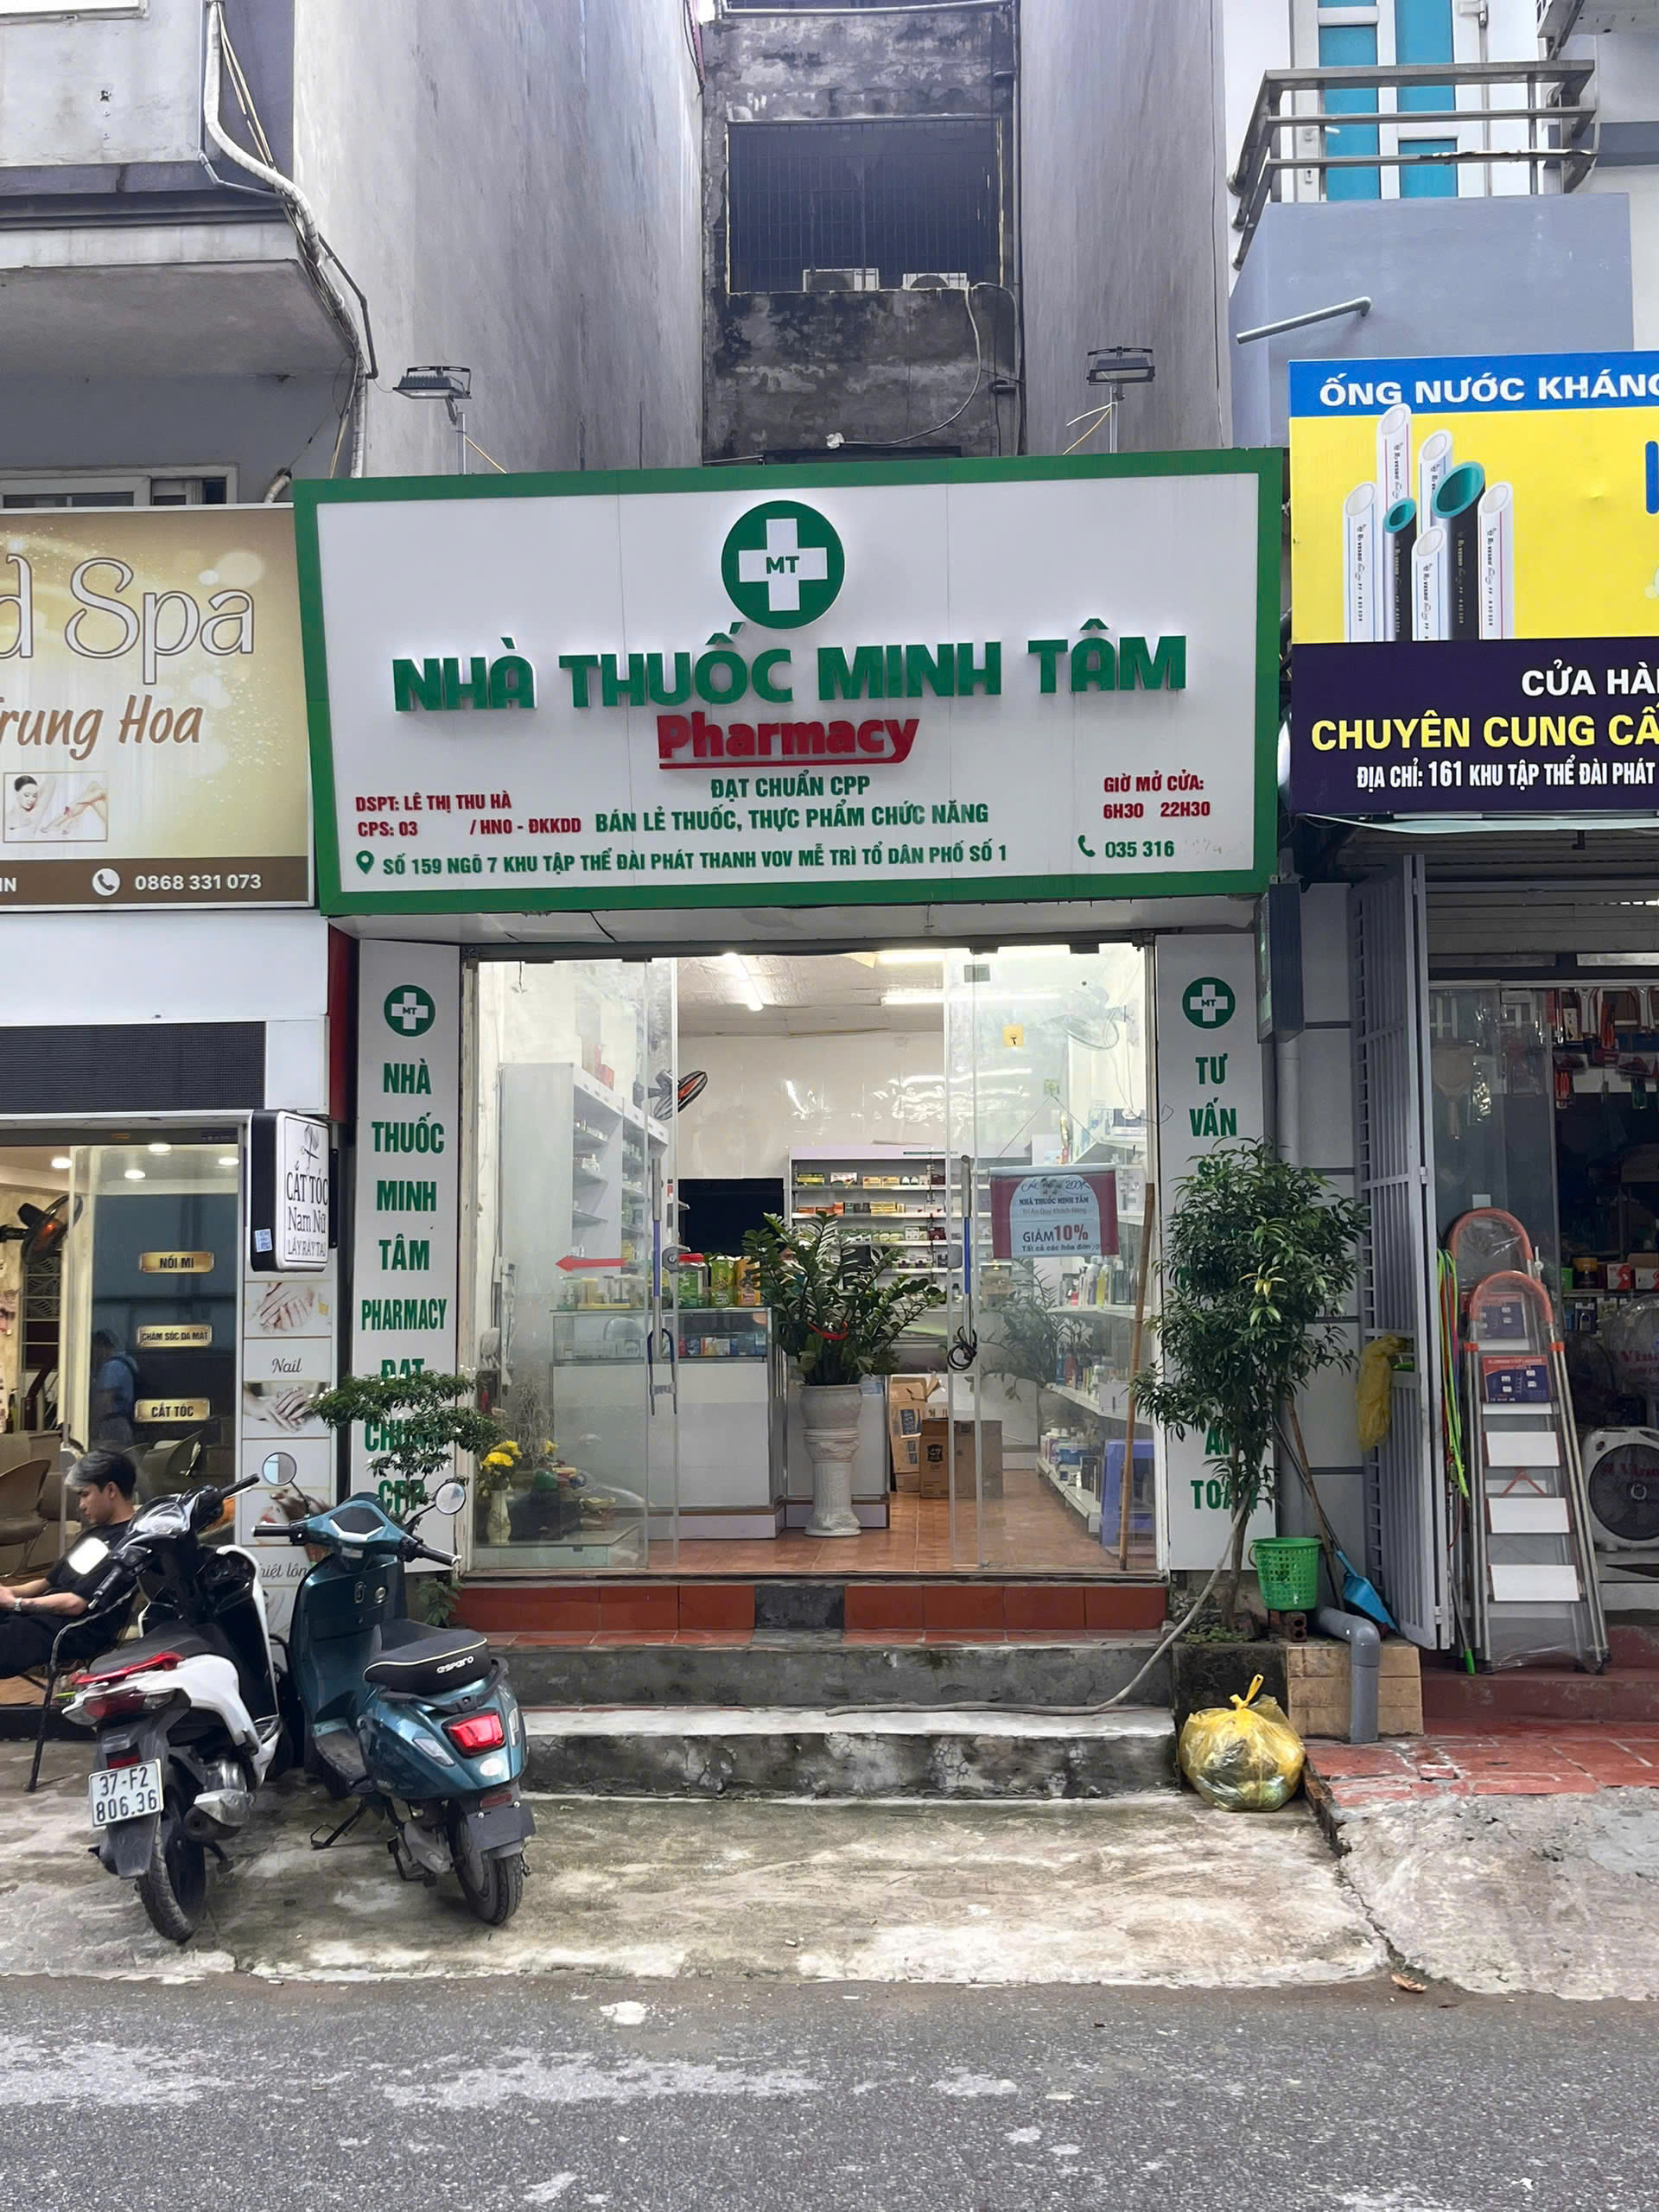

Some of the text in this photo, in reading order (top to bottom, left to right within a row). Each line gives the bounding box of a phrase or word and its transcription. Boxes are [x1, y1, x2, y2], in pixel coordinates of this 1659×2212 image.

[1319, 373, 1402, 406] ỐNG
[1415, 372, 1525, 404] NƯỚC
[766, 556, 800, 574] MT
[64, 556, 254, 685] Spa
[392, 618, 1187, 711] NHÀ THUỐC MINH TÂM
[1522, 658, 1659, 696] CỬA HÀ
[0, 695, 204, 761] rung Hoa
[657, 711, 920, 769] Pharmacy
[1311, 710, 1470, 751] CHUYÊN
[1483, 715, 1595, 747] CUNG
[710, 769, 871, 802] ĐẠT CHUẨN CPP
[1103, 769, 1204, 792] GIỜ MỞ CỬA:
[1357, 754, 1656, 793] ĐỊA CHỈ: 161 KHU TẬP THỂ ĐÀI PHÁT
[355, 791, 512, 813] DSPT: LÊ THỊ THU HÀ
[595, 799, 988, 832] BÁN LẺ THUỐC, THỰC PHẨM CHỨC NĂNG
[1103, 801, 1211, 819] 6H30 22H30
[358, 821, 395, 836] CPS:
[398, 821, 418, 836] 03
[528, 817, 582, 834] ĐKKDD
[383, 838, 1006, 875] SỐ 159 NGÕ 7 KHU TẬP THỂ ĐÀI PHÁT THANH VOV MỄ TRÌ TỔ DÂN PHỐ SỐ 1
[1105, 841, 1137, 858] 035
[1143, 841, 1174, 857] 316
[135, 874, 262, 890] 0868 331 073
[383, 1058, 432, 1094] NHÀ
[1195, 1053, 1228, 1084] TƯ
[372, 1111, 445, 1154] THUỐC
[1189, 1097, 1237, 1136] VẤN
[286, 1160, 328, 1205] CẮT TÓC
[377, 1180, 437, 1212] MINH
[1020, 1197, 1033, 1205] NHÀ
[288, 1206, 311, 1233] Nam
[1022, 1224, 1088, 1243] GIẢM 10%
[181, 1257, 194, 1268] MI
[378, 1233, 429, 1270] TÂM
[361, 1298, 448, 1331] PHARMACY
[272, 1358, 302, 1374] Nail
[99, 1766, 149, 1796] 37-F2
[96, 1789, 156, 1822] 806.36
